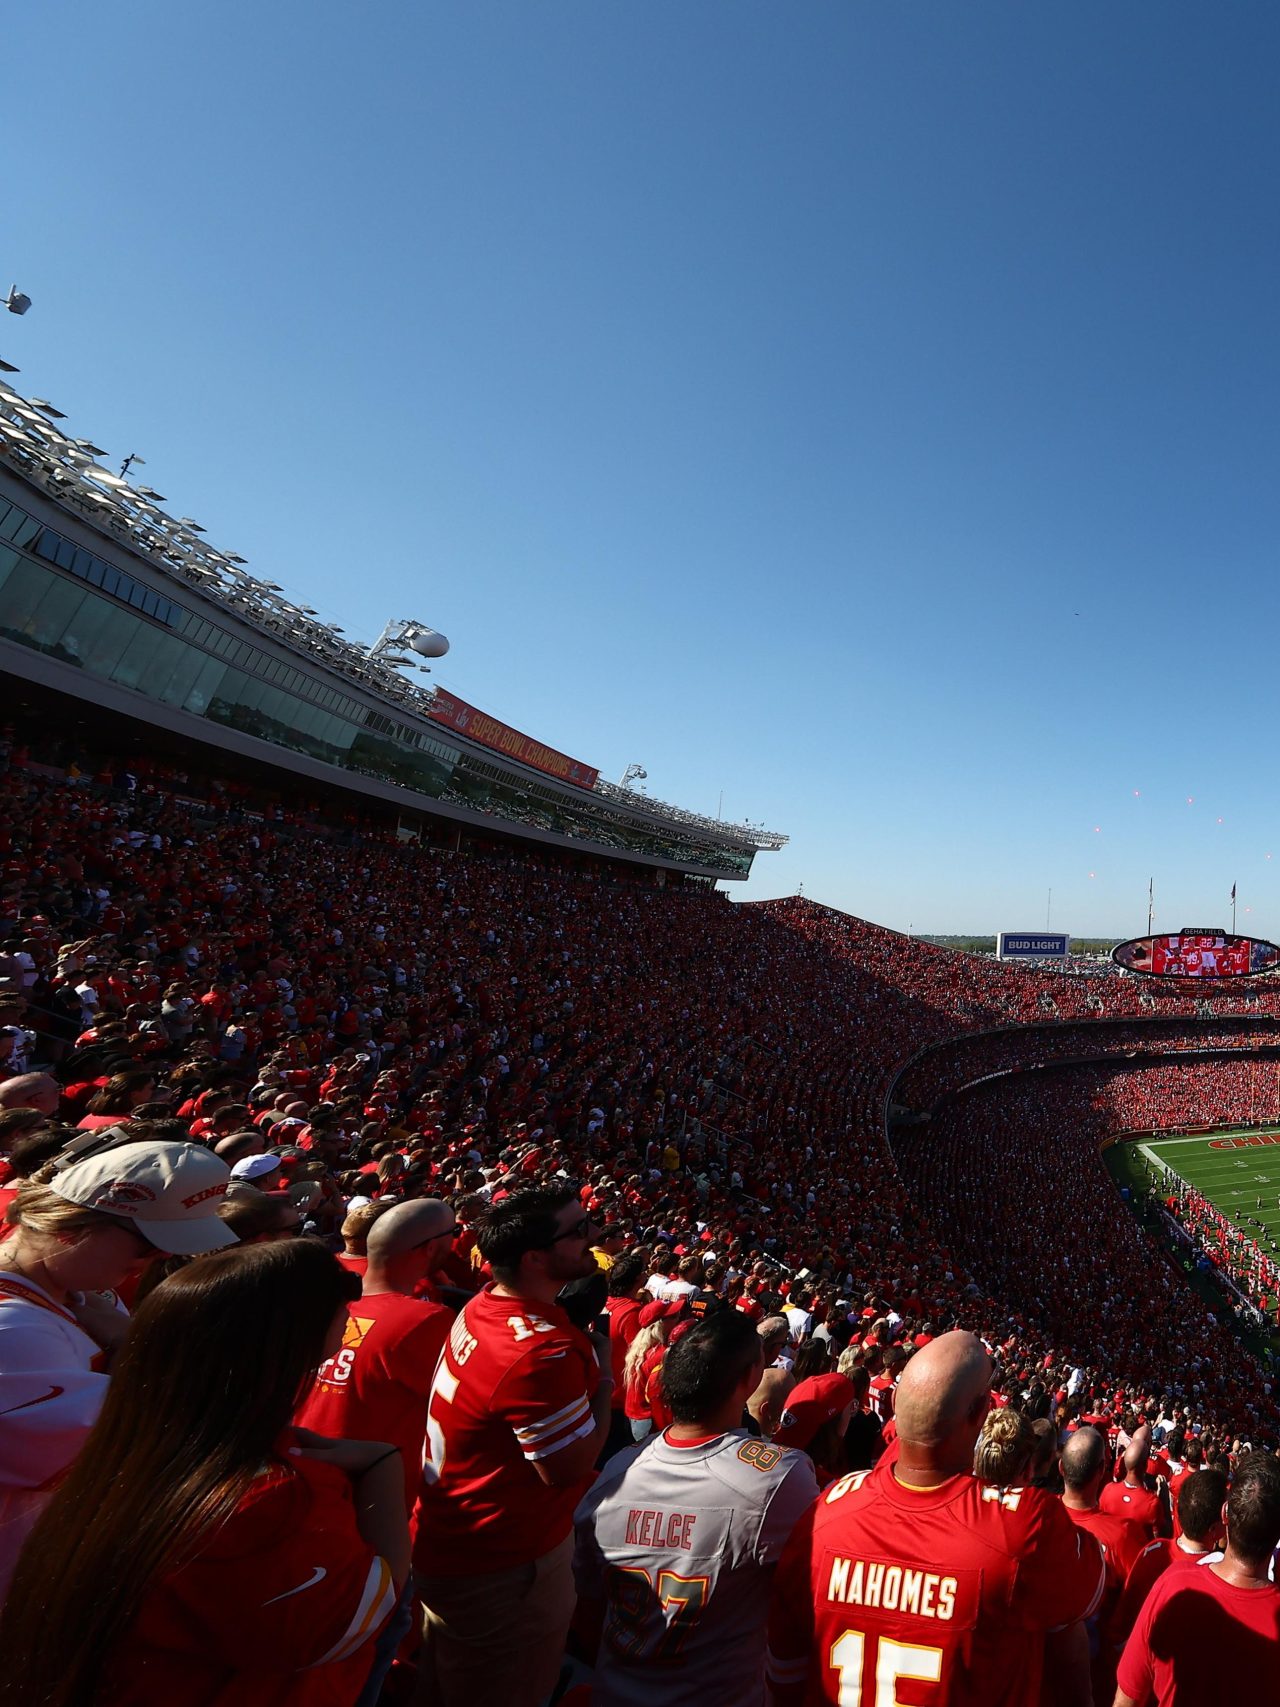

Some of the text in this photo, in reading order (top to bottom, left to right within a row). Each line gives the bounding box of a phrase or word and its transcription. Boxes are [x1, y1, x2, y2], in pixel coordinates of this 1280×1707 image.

[470, 714, 570, 776] SUPER BOWL CHAMPIONS
[1008, 941, 1061, 950] BUD LIGHT
[737, 1440, 791, 1472] 8
[625, 1509, 696, 1550] KELCE
[604, 1565, 710, 1666] 87
[827, 1557, 957, 1621] MAHOMES
[829, 1629, 943, 1707] 15
